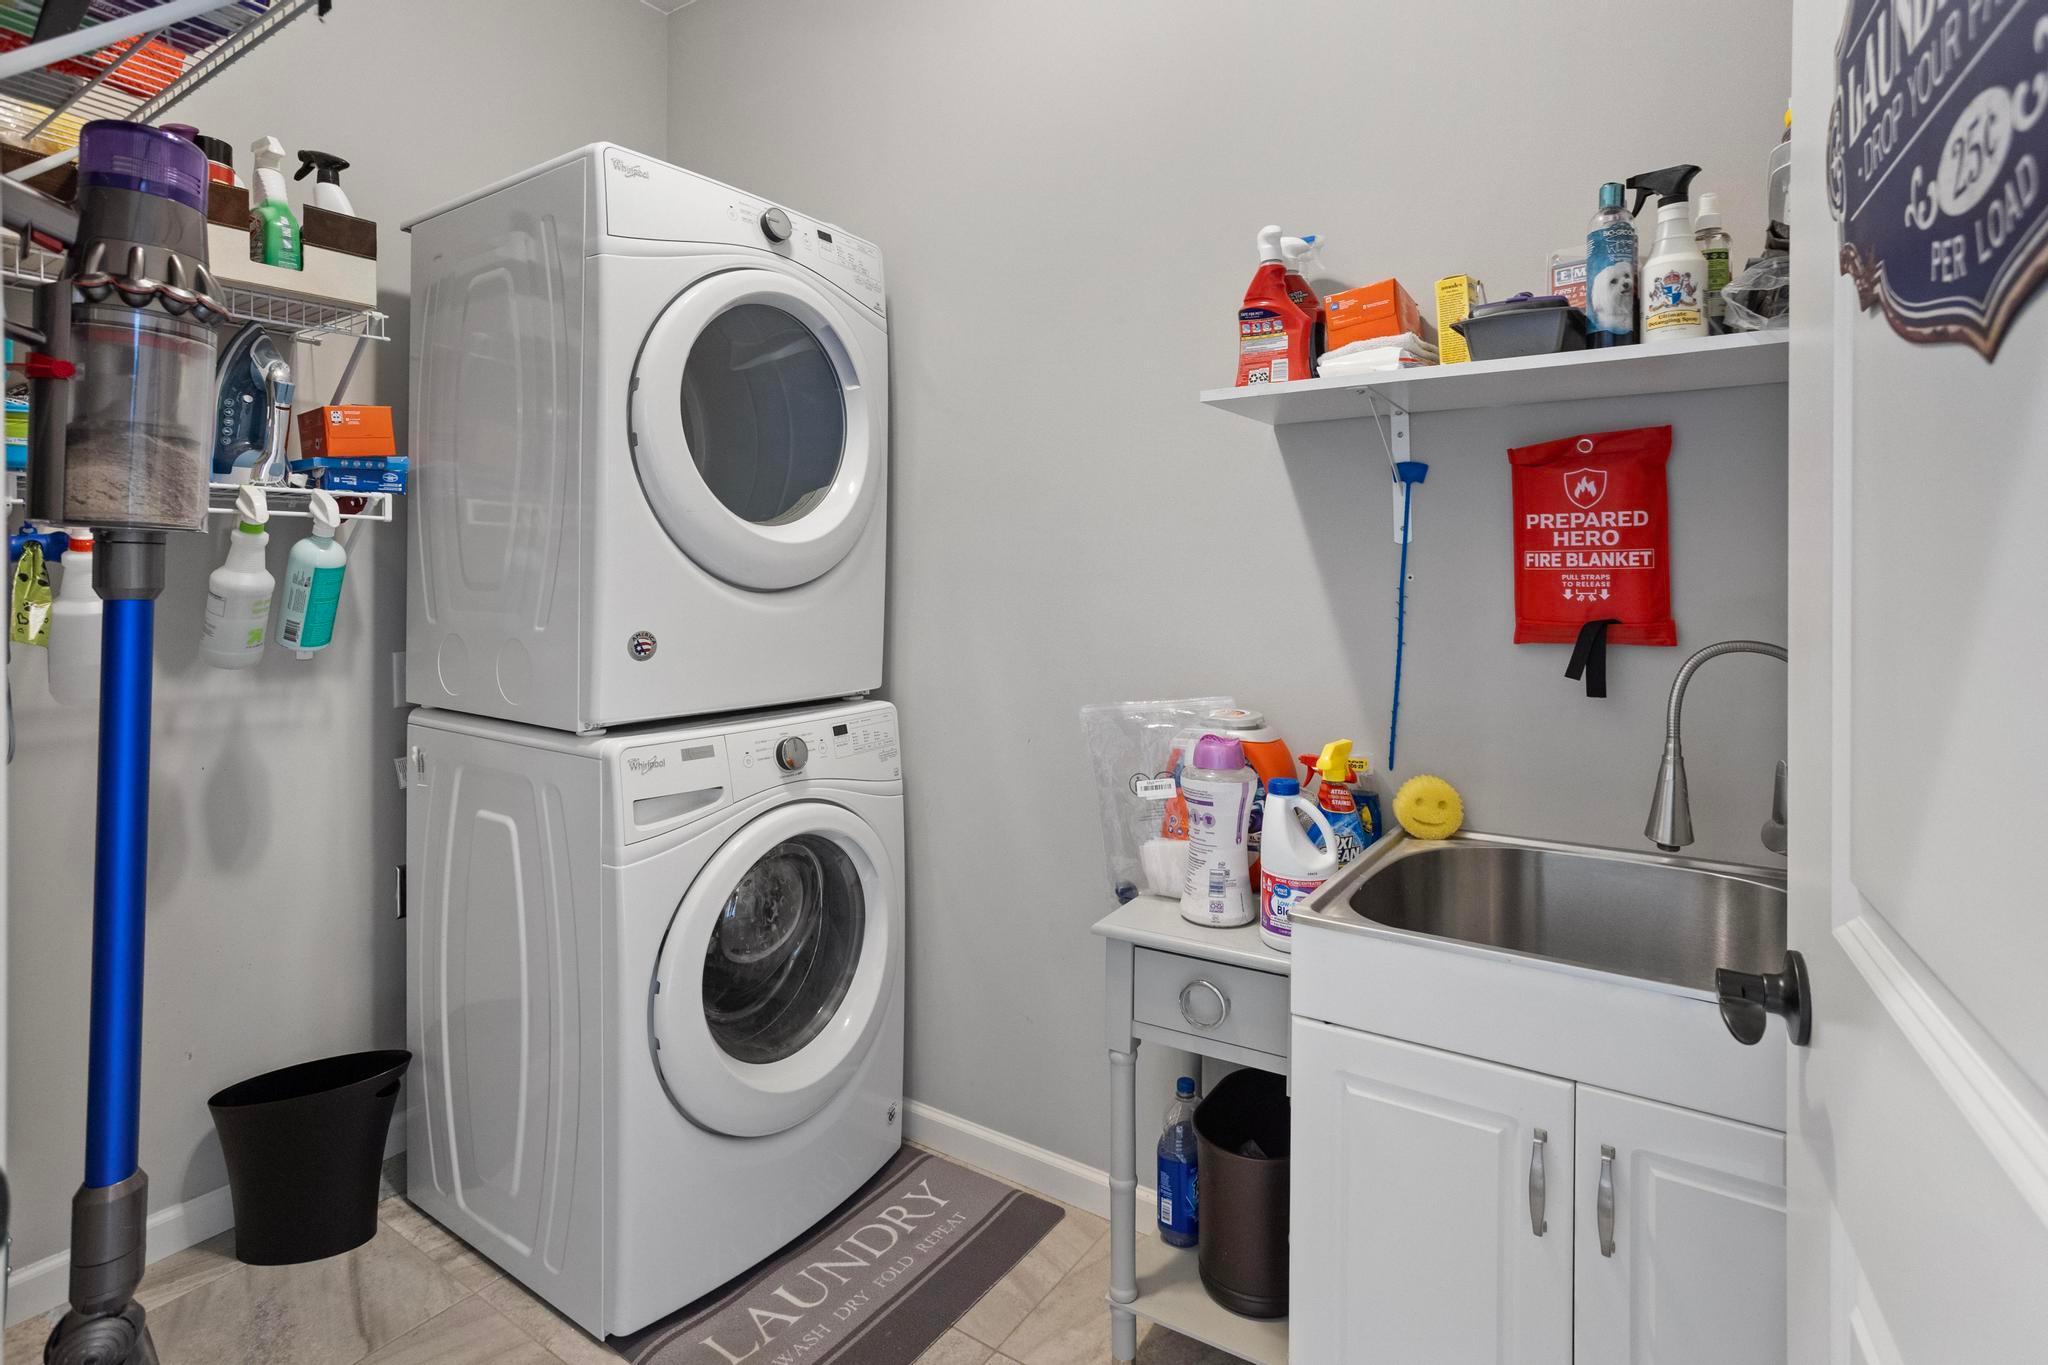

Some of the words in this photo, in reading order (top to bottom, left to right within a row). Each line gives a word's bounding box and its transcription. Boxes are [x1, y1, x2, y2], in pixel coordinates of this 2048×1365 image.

[1848, 0, 1947, 148] LAUN
[1863, 92, 1904, 181] DROP
[1906, 9, 1962, 117] YOUR
[1930, 234, 1968, 284] PER
[1975, 154, 2039, 264] LOAD
[1526, 510, 1649, 529] PREPARED
[1553, 529, 1620, 547] HERO
[1526, 552, 1561, 567] FIRE
[1566, 551, 1652, 567] BLANKET
[627, 755, 666, 775] Whirlpool
[1336, 846, 1361, 864] EAN
[699, 1178, 949, 1365] LAUNDRY
[771, 1323, 832, 1365] WASH
[833, 1289, 870, 1321] DRY
[873, 1256, 914, 1288] FOLD
[915, 1211, 967, 1253] REPEAT
